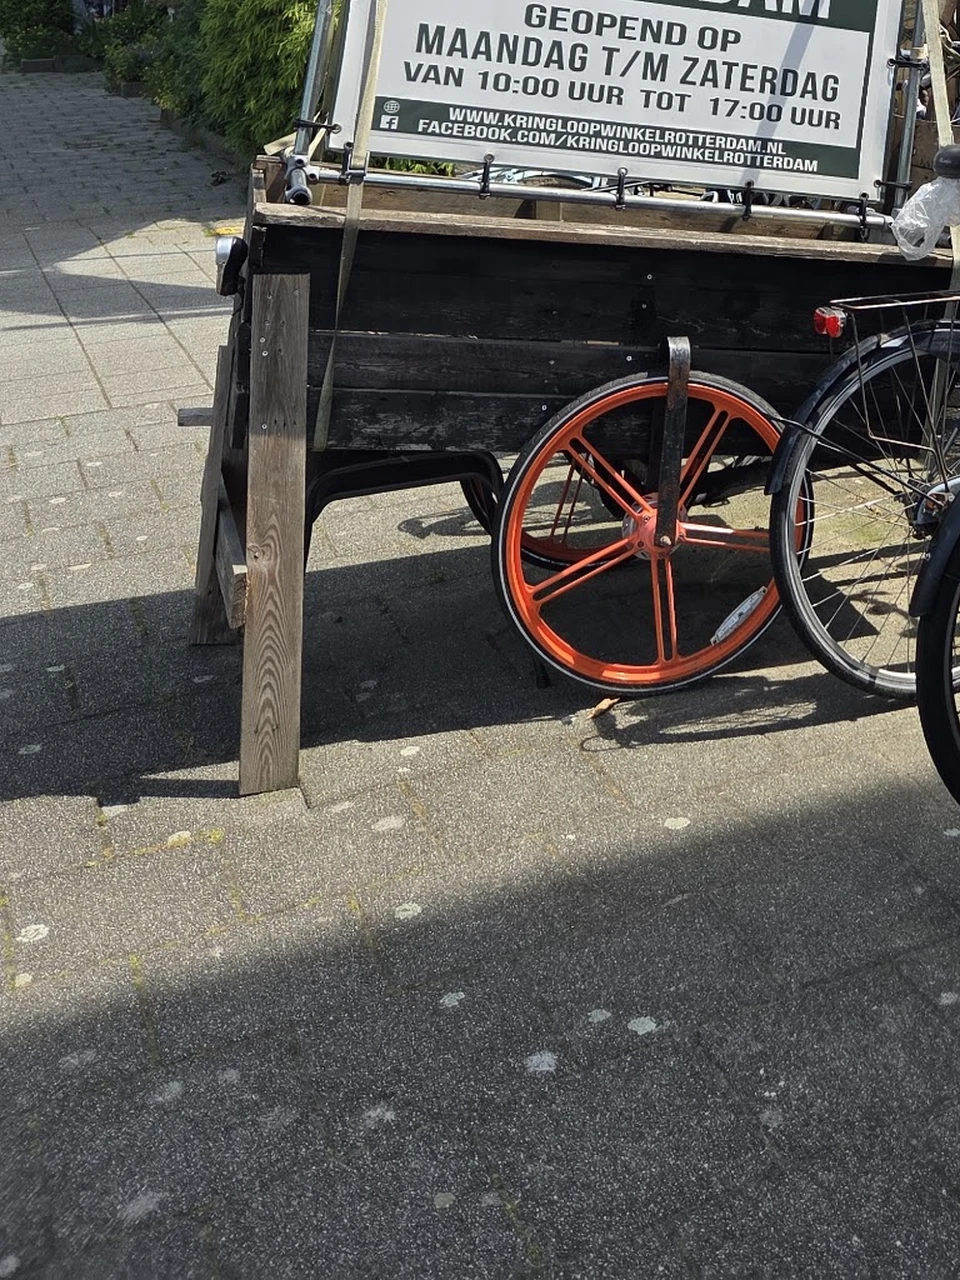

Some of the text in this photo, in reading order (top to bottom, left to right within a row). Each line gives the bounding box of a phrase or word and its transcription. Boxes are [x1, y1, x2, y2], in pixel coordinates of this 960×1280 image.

[524, 2, 742, 53] GEOPEND OP
[415, 23, 840, 103] MAANDAG T/M ZATERDAG
[403, 62, 841, 130] VAN 10:00 UUR TOT 17:00 UUR
[418, 119, 817, 173] FACEBOOK.COM/KRINGLOOPWINKELROTTERDAM
[448, 107, 787, 155] WWW.KRINGLOOPWINKELROTTERDAM.NL
